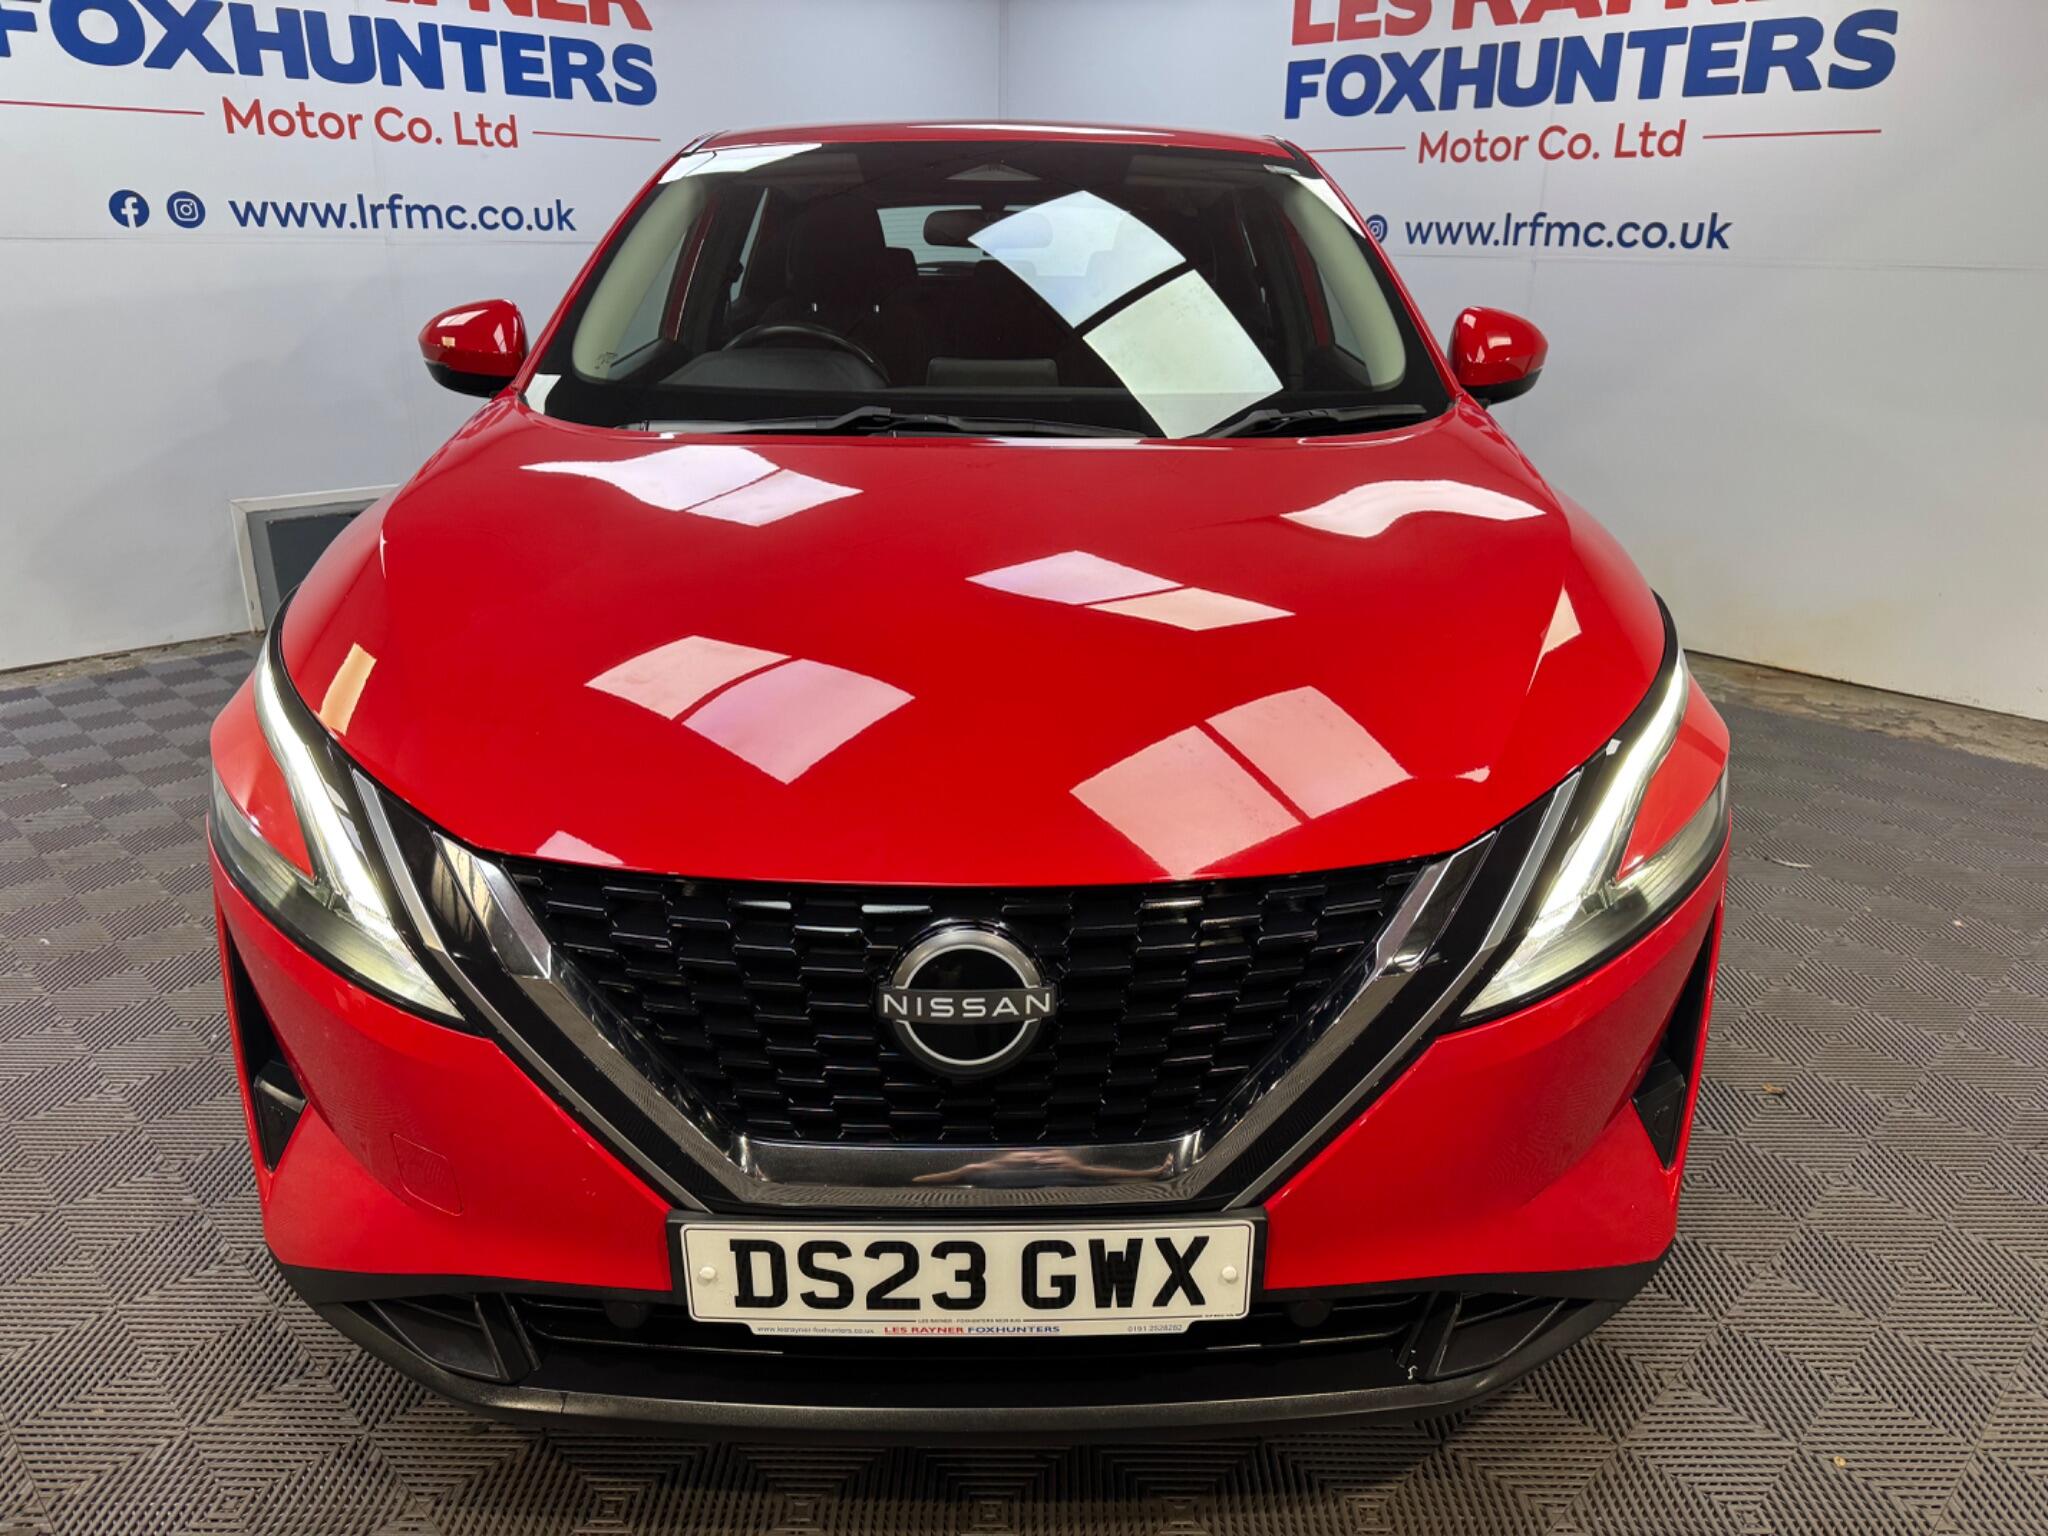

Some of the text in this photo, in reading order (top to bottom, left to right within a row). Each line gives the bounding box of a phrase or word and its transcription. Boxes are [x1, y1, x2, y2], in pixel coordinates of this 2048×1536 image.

[1284, 9, 1898, 119] FOXHUNTERS
[222, 96, 518, 149] Motor Co. Ltd
[1418, 118, 1687, 164] Motor Co. Ltd
[228, 192, 577, 233] www.lrfmc.co.uk
[1405, 212, 1731, 251] www.lrfmc.co.uk
[883, 992, 1050, 1018] NISSAN
[729, 1235, 1210, 1311] DS23 GWX
[884, 1325, 1060, 1334] LES RAYNER FOXHUNTERS
